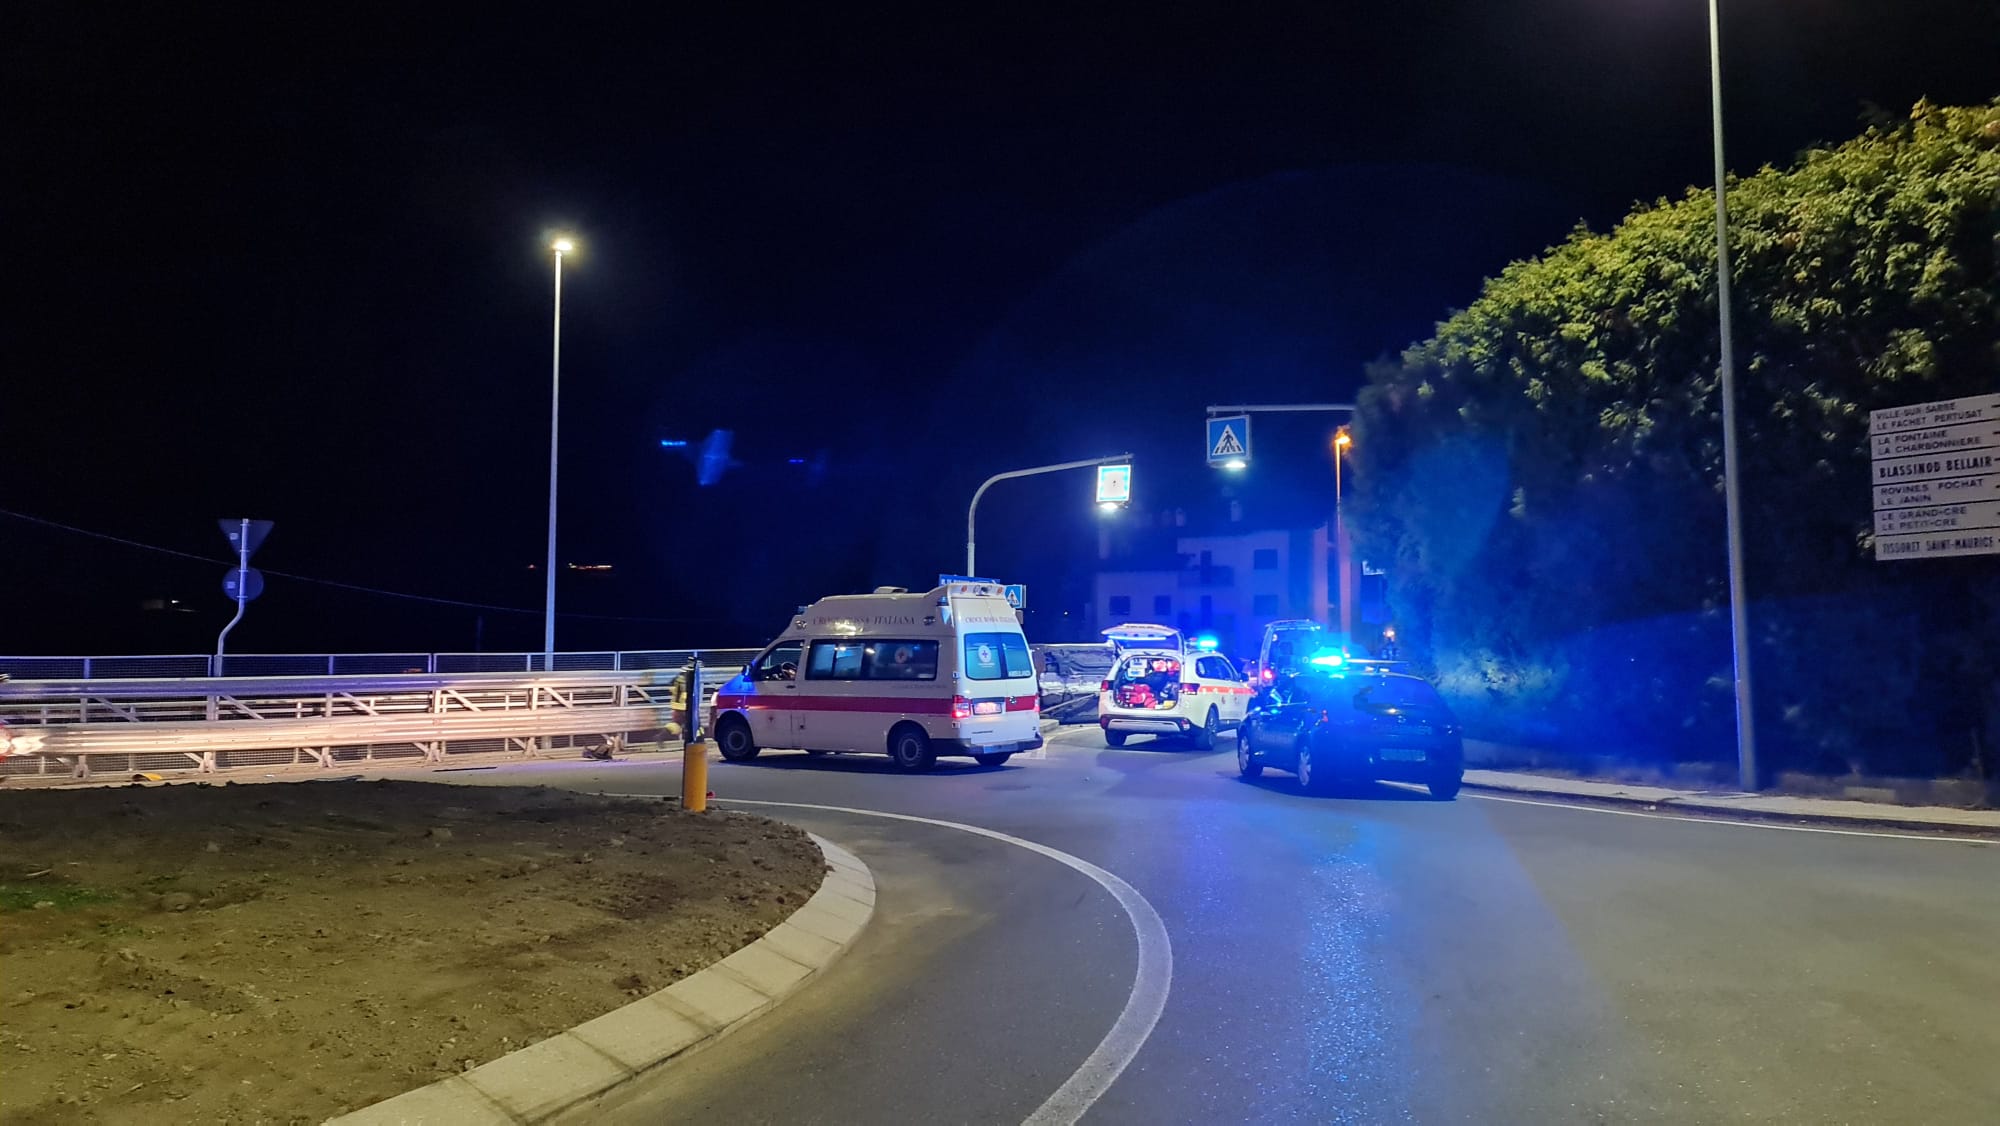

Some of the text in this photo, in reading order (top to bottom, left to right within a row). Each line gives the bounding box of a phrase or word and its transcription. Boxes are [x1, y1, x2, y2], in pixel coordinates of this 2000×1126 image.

[1877, 422, 1887, 430] LE
[1879, 430, 1947, 445] LA FONTAINE
[1879, 447, 1890, 455] LA
[1880, 456, 1992, 478] BLASSINOD BELLAIR
